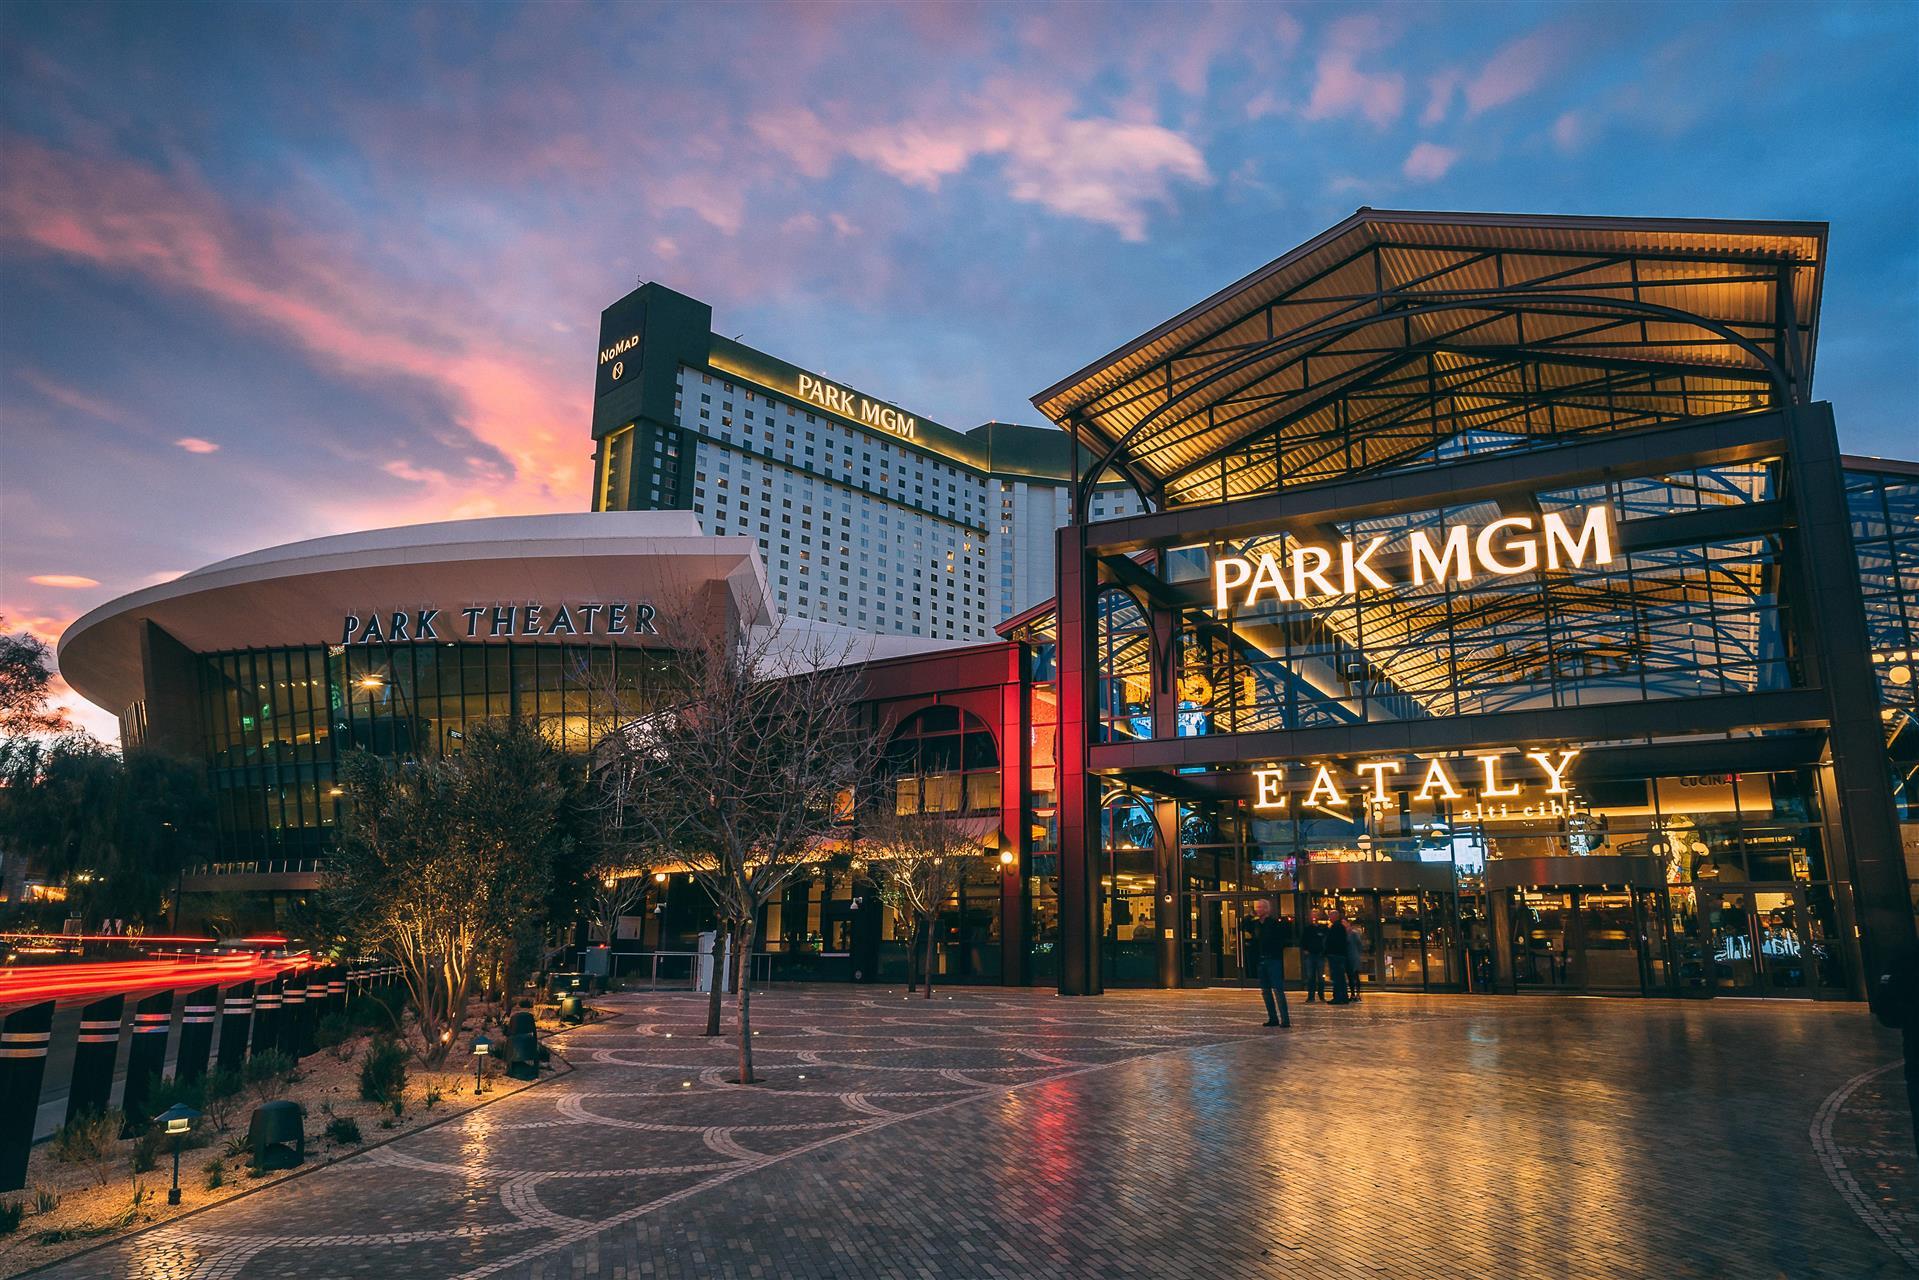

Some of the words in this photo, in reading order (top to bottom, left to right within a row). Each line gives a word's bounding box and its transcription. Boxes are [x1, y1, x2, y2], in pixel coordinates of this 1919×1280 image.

[798, 374, 856, 417] PARK
[861, 400, 914, 439] MGM
[1215, 536, 1393, 611] PARK
[1410, 506, 1612, 586] MGM
[343, 609, 441, 645] PARK
[462, 603, 659, 637] THEATER
[1253, 750, 1580, 808] EATALY
[1462, 803, 1508, 820] alti
[1523, 800, 1576, 818] cibi
